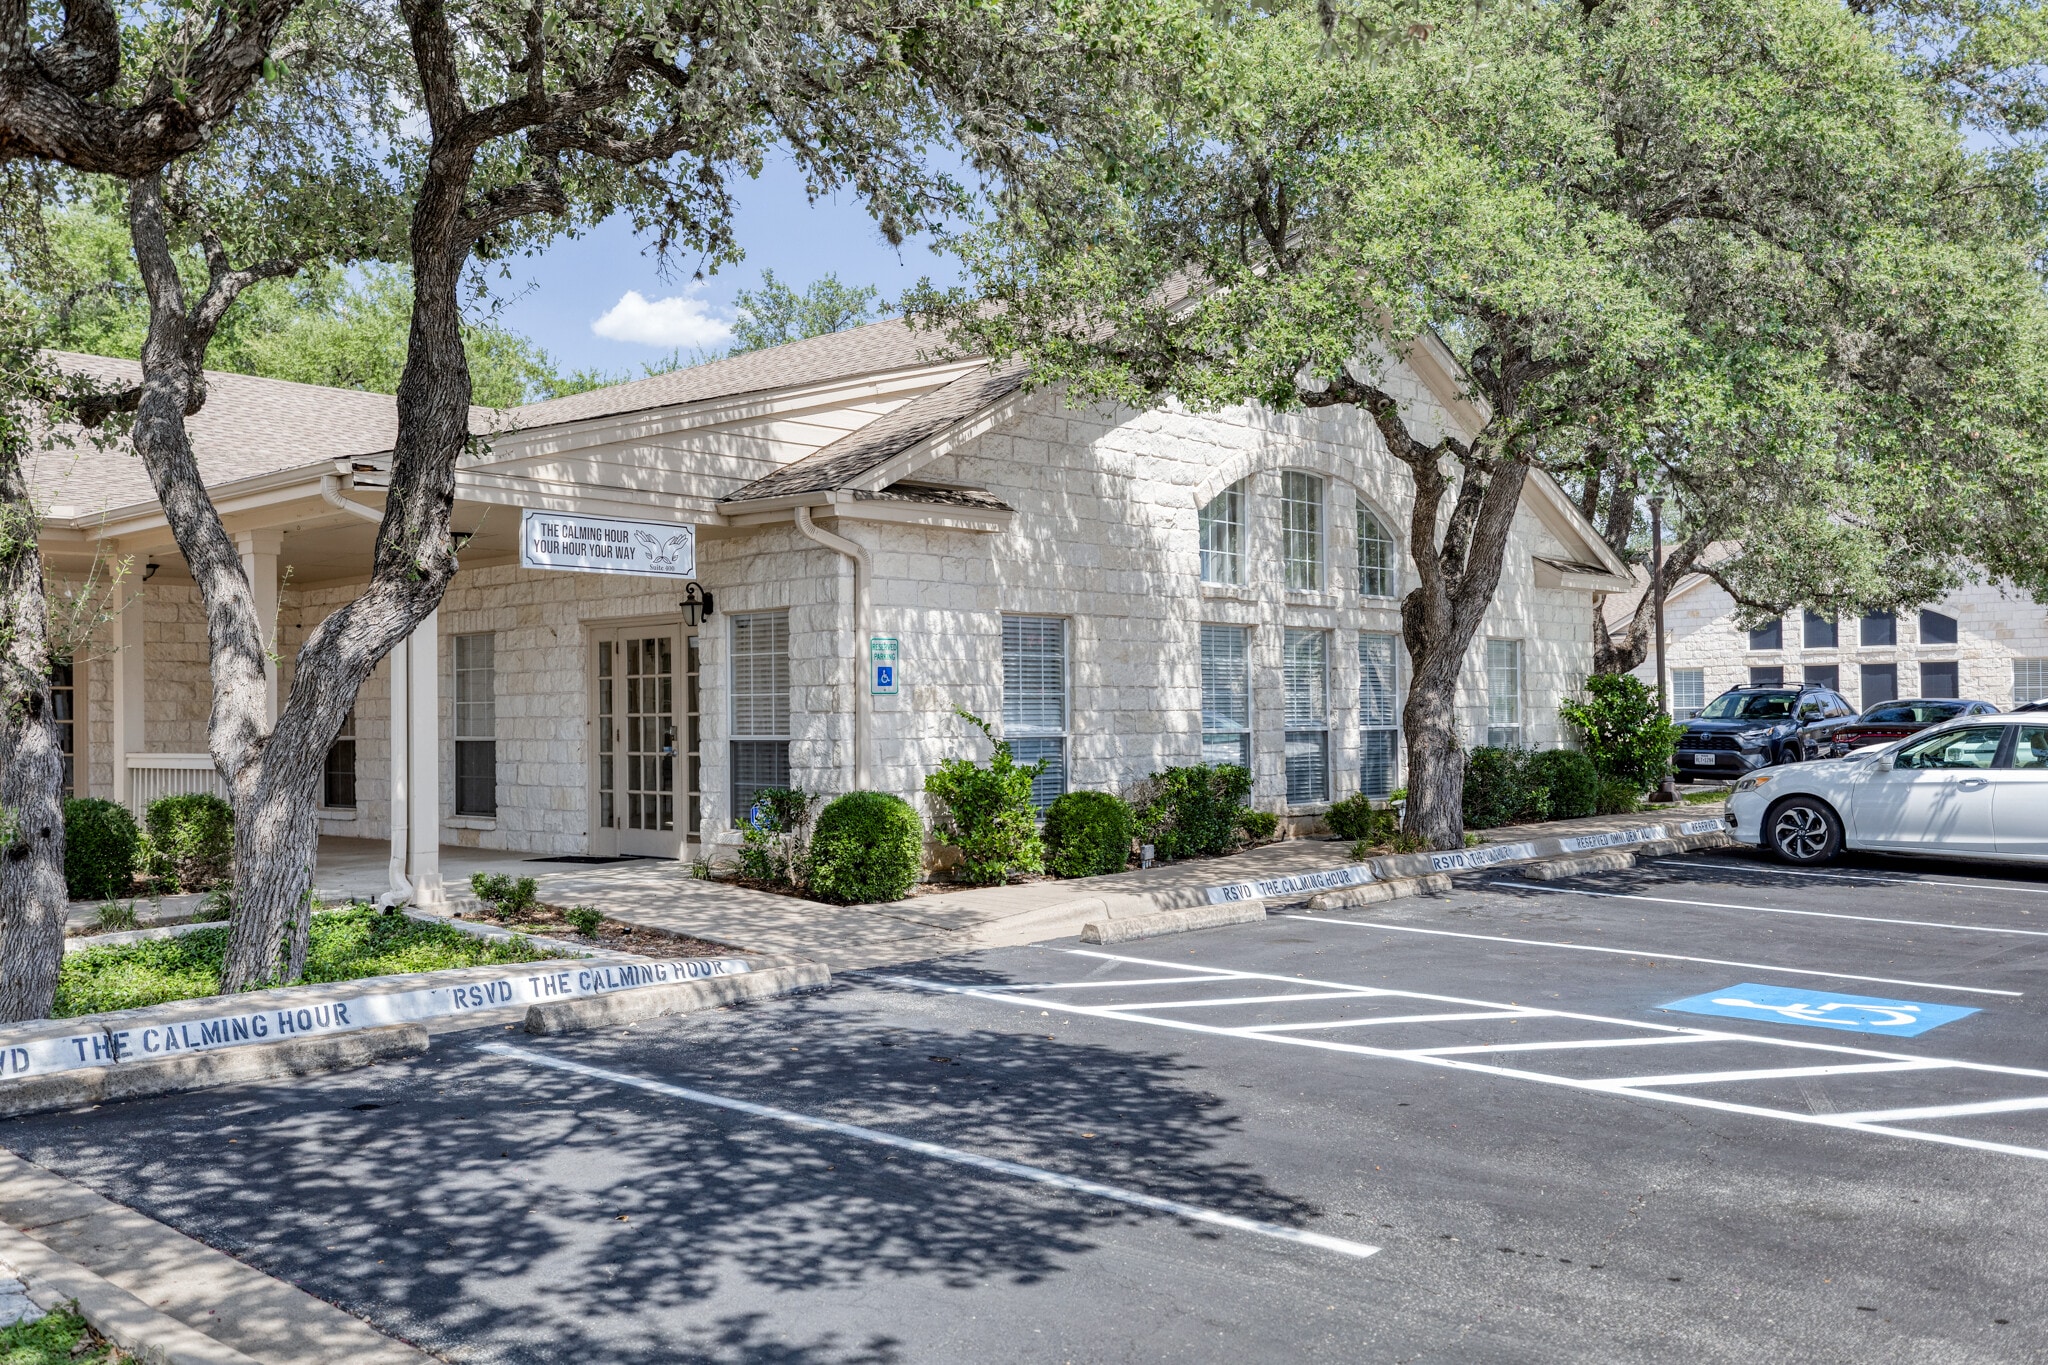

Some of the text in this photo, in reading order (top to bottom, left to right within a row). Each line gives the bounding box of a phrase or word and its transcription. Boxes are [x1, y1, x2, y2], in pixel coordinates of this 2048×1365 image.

[541, 523, 629, 543] THE CALMING HOUR
[534, 539, 636, 560] YOUR HOUR YOUR WAY
[1576, 834, 1608, 849] RESERVED
[1432, 855, 1464, 870] RSVD
[1222, 870, 1352, 901] RSVD THE CALMING HOUR
[453, 959, 727, 1009] RSVD THE CALMING HOUR
[71, 1032, 133, 1062] THE
[143, 1014, 268, 1053] CALMING
[277, 1002, 351, 1035] HOUR
